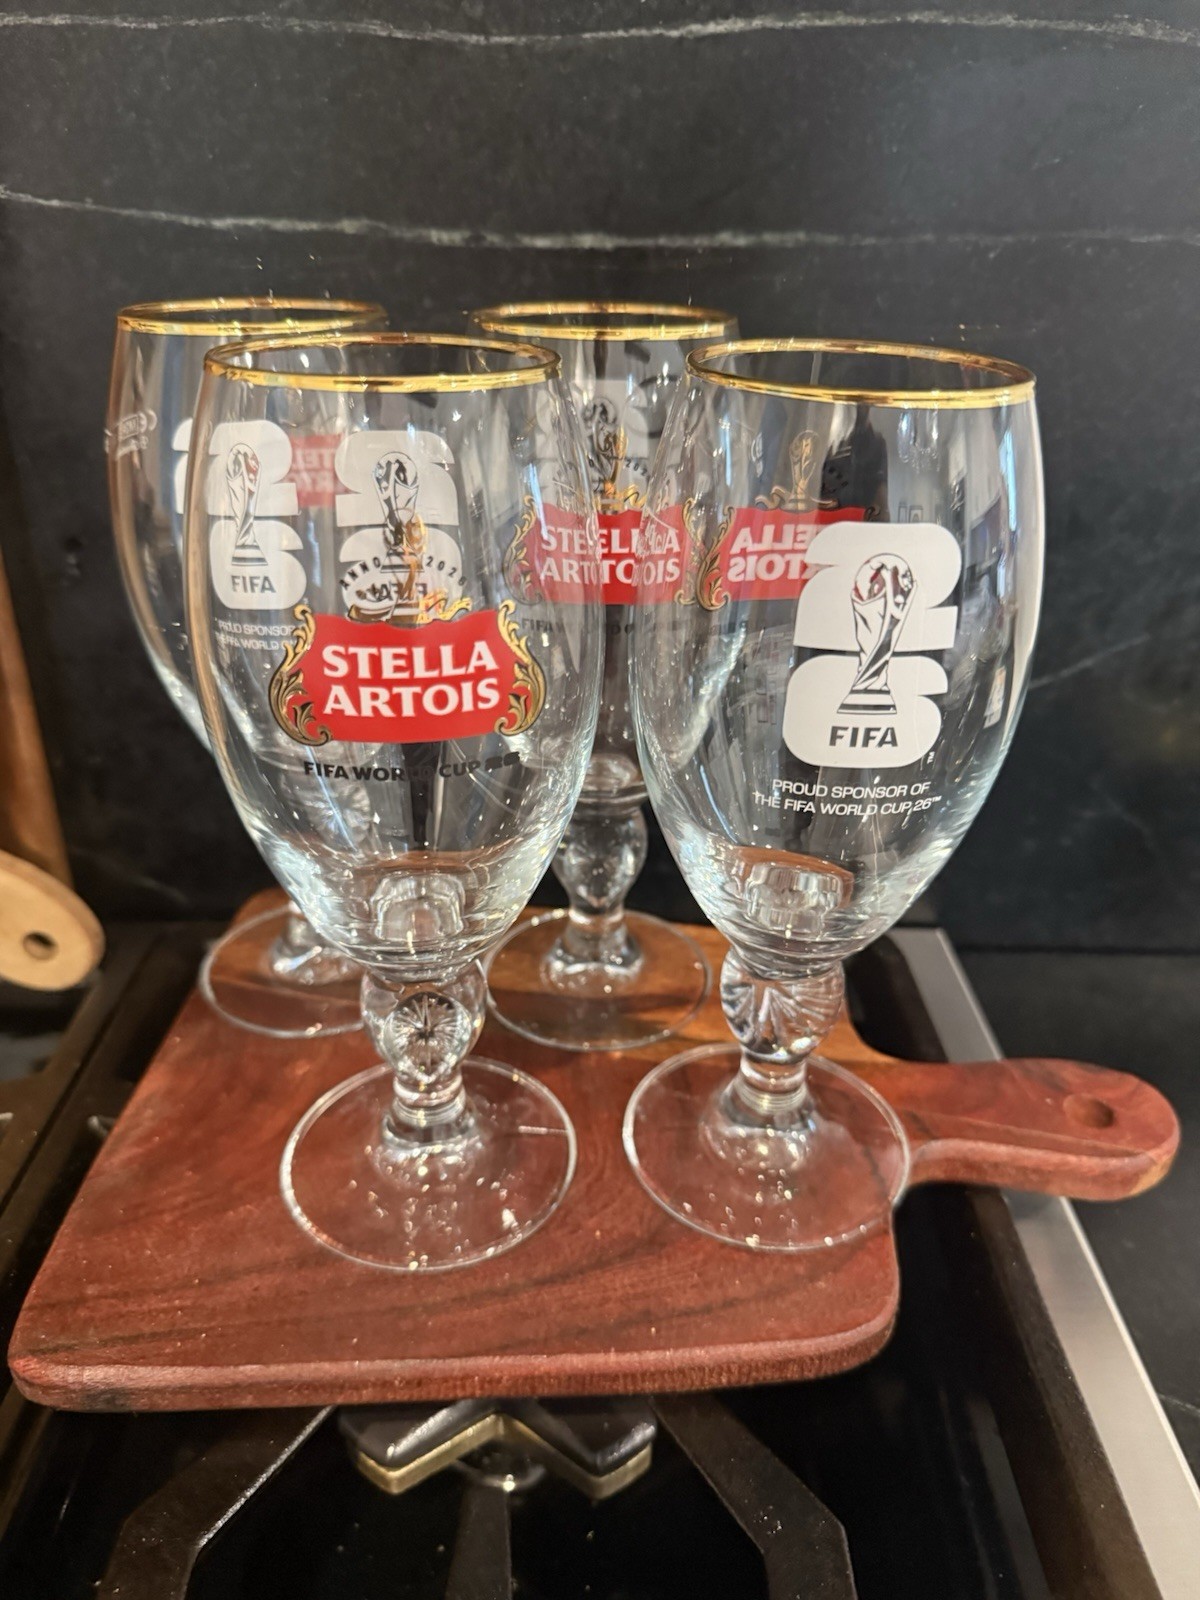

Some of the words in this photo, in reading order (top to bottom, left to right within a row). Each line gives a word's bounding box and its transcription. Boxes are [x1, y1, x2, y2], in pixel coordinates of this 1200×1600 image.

[231, 574, 276, 594] FIFA
[321, 640, 500, 680] STELLA
[322, 677, 501, 718] ARTOIS
[829, 725, 899, 748] FIFA
[303, 760, 350, 781] FIFA
[438, 759, 481, 778] CUP
[772, 778, 829, 797] PROUD
[831, 785, 908, 800] SPONSOR
[909, 781, 932, 796] OF
[754, 793, 781, 809] THE
[784, 798, 817, 813] FIFA
[819, 802, 878, 816] WORLD
[880, 801, 912, 815] CUP
